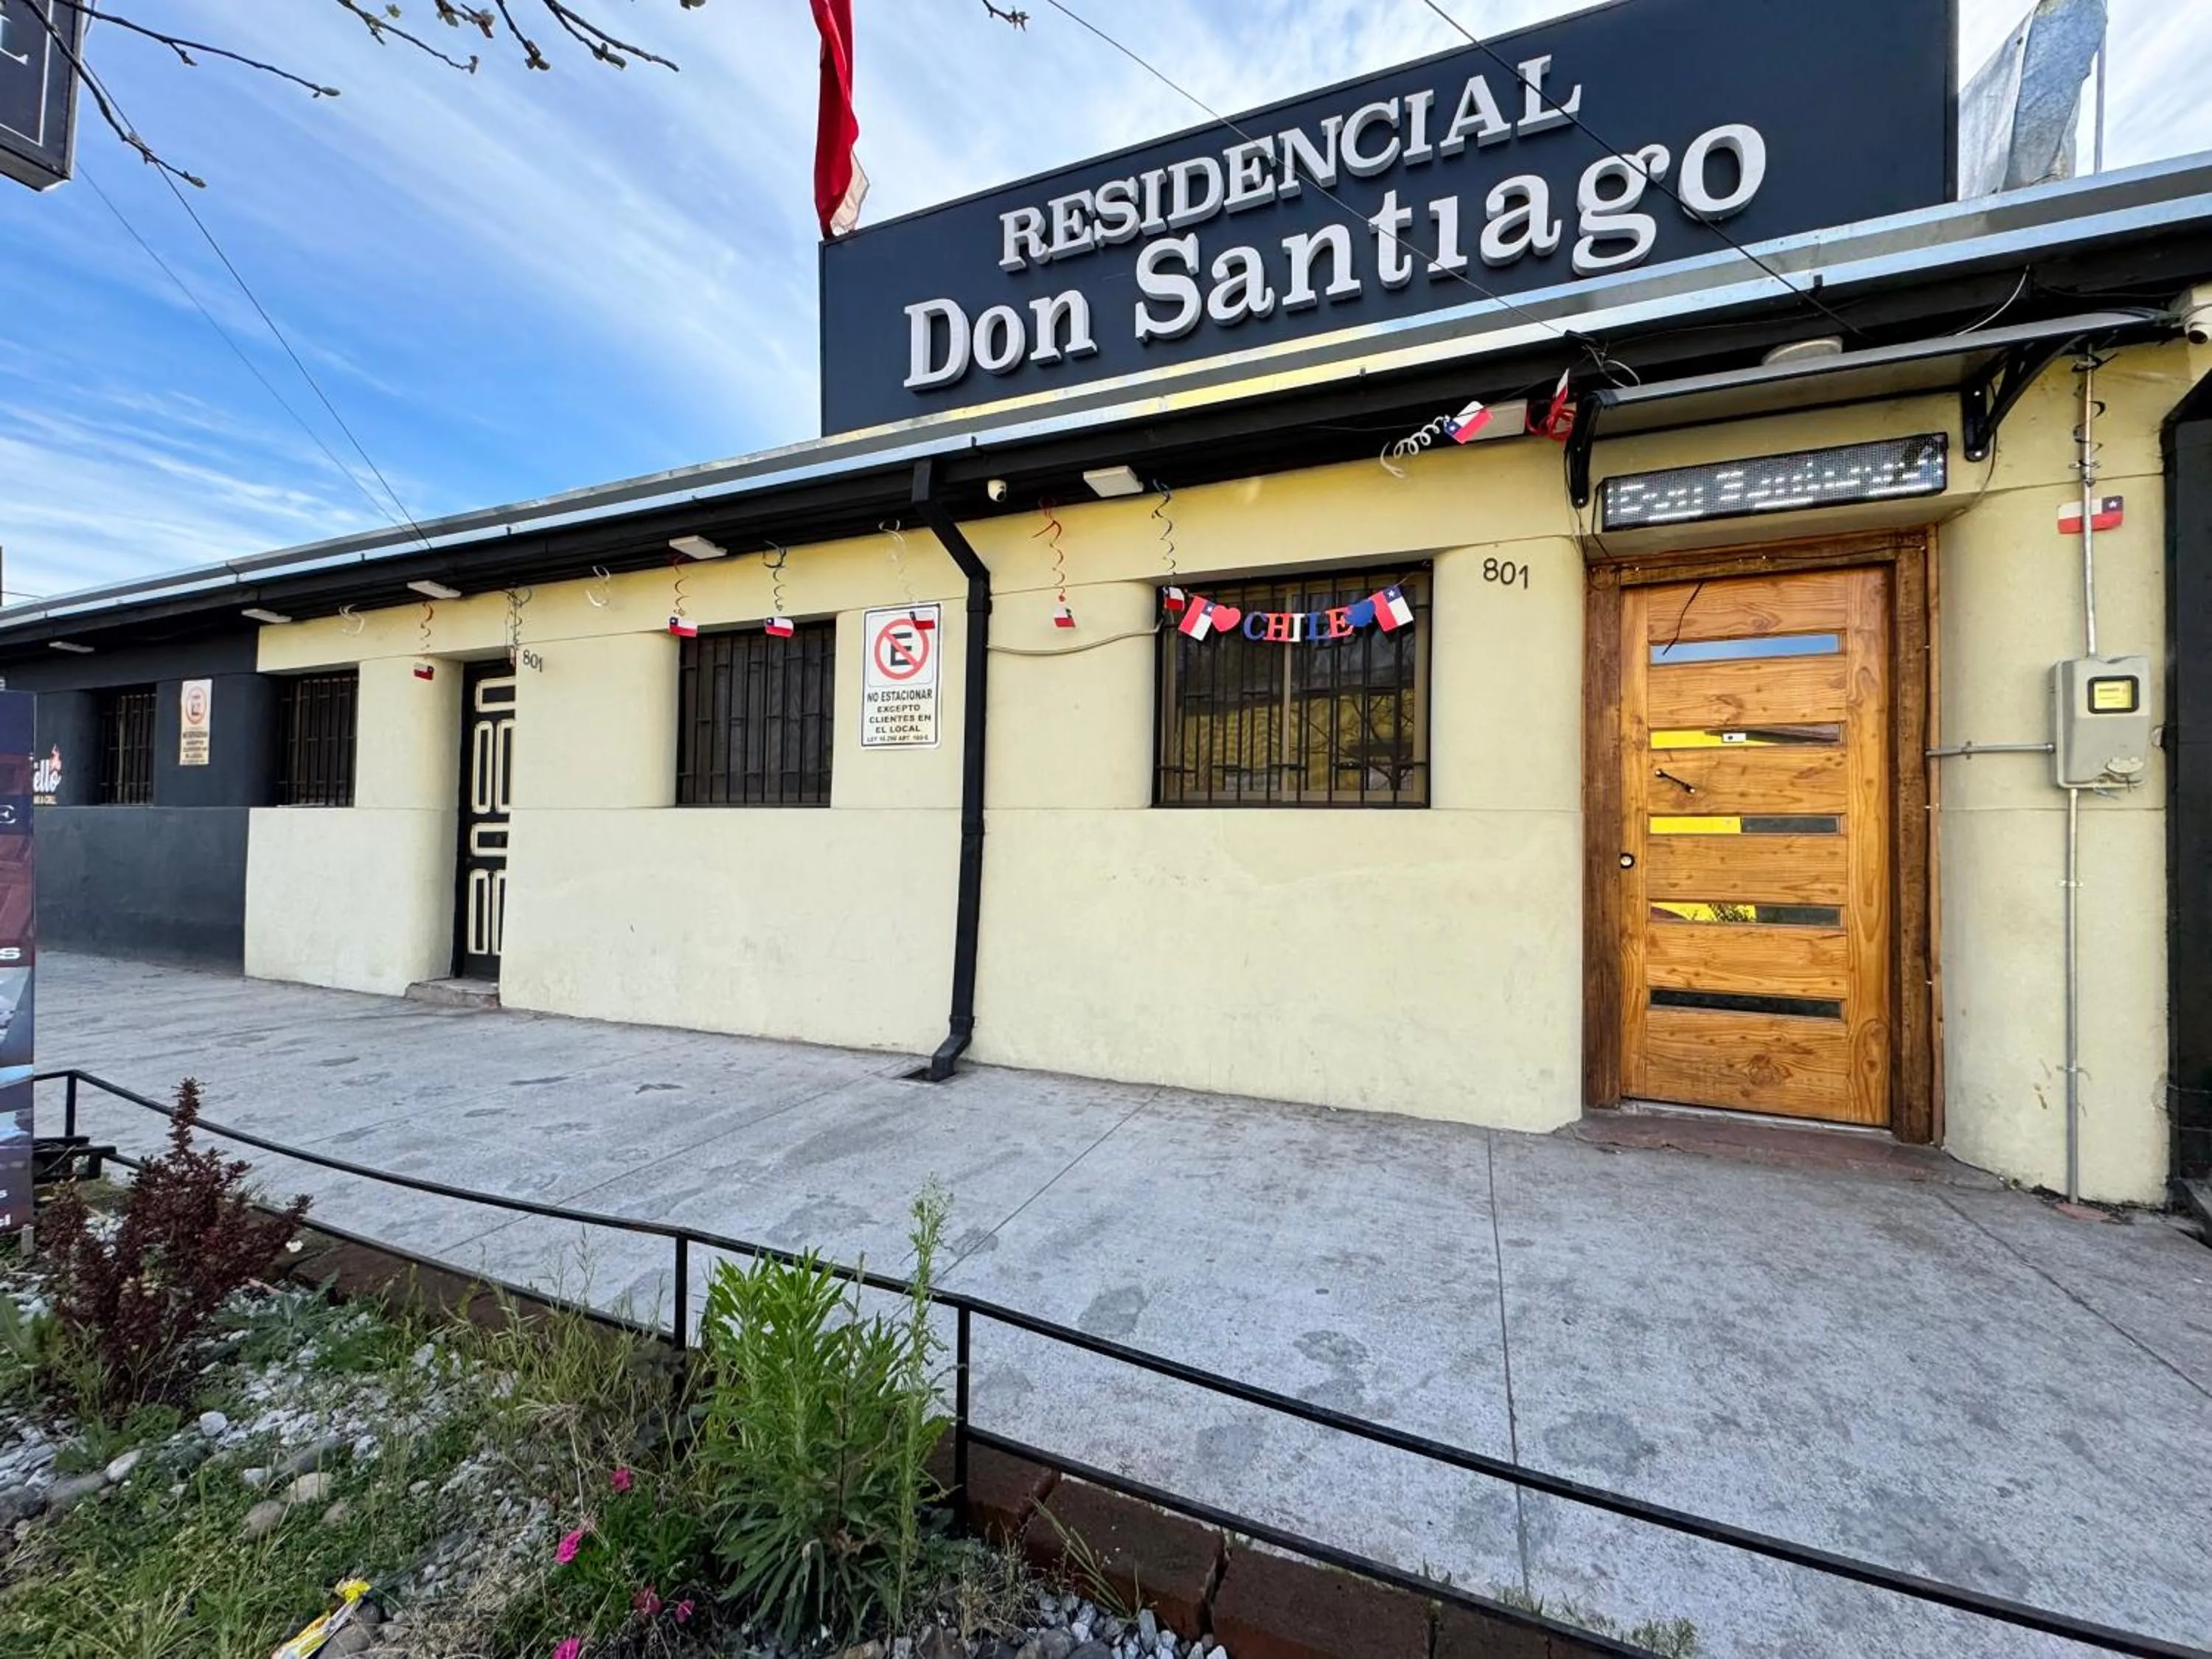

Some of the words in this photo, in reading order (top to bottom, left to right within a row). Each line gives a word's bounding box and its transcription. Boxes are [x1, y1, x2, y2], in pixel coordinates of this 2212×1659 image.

[998, 54, 1582, 272] RESIDENCIAL
[904, 290, 1098, 392] Don
[1135, 123, 1767, 342] Santiago
[1483, 557, 1528, 591] 801
[1242, 606, 1354, 642] CHILE
[523, 649, 543, 673] 801
[867, 692, 880, 703] NO
[881, 688, 933, 702] ESTACIONAR
[869, 714, 915, 723] CLIENTES
[917, 714, 931, 722] EN
[877, 703, 921, 713] EXCEPTO
[889, 725, 921, 734] LOCAL
